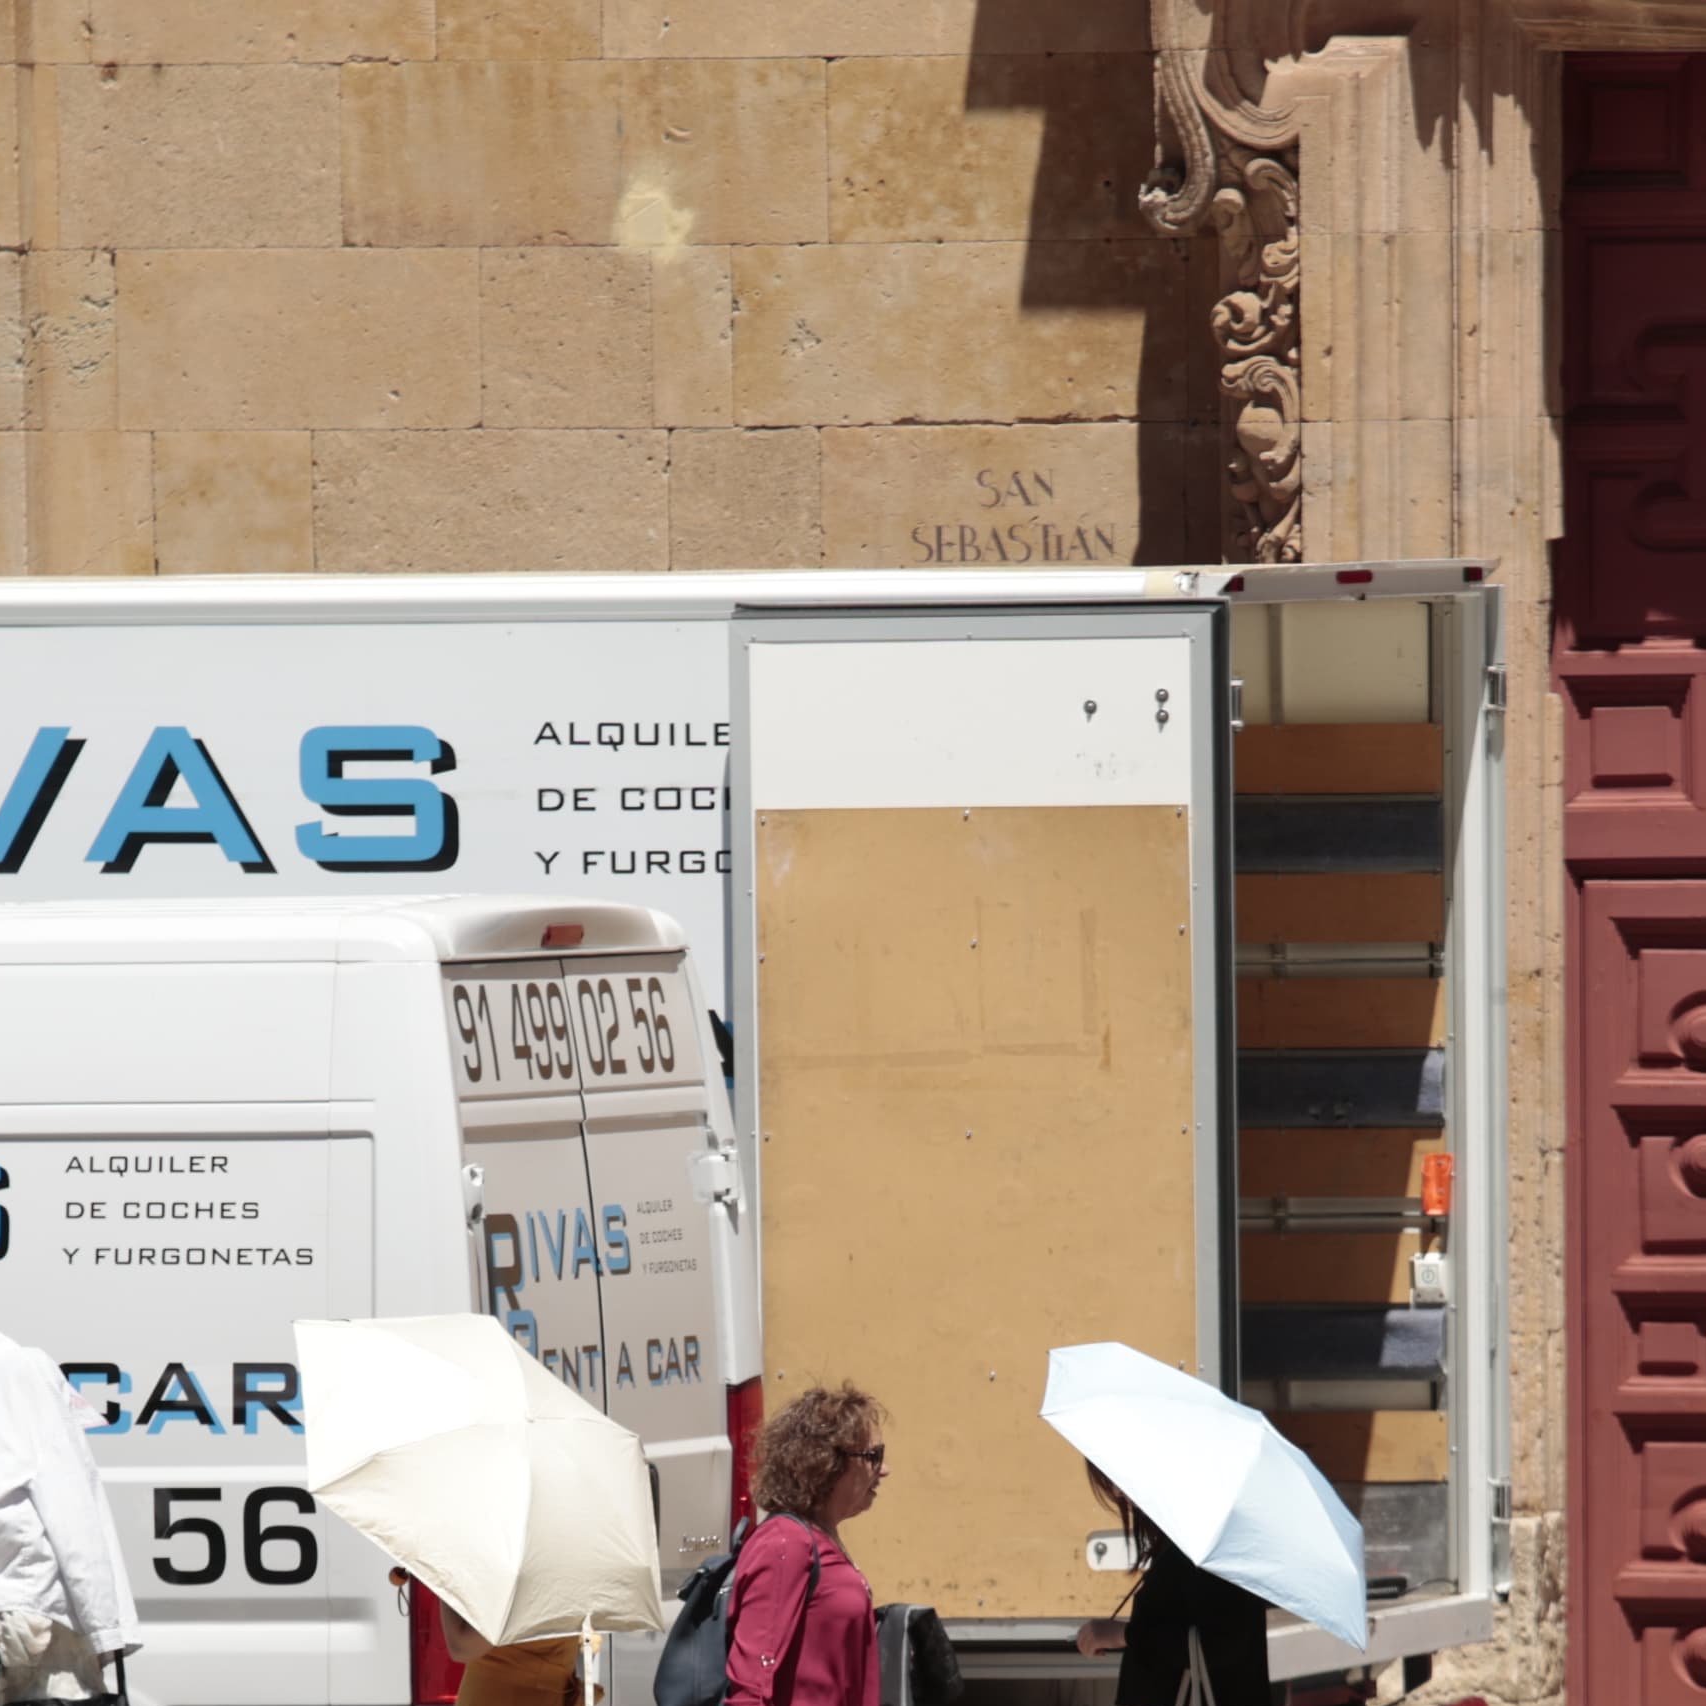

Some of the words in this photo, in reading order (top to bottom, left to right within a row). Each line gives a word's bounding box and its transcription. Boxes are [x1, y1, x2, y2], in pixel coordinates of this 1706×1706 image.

[976, 468, 1059, 508] SAN
[537, 788, 597, 811] DE
[534, 851, 560, 875] Y
[453, 984, 500, 1082] 91
[511, 982, 573, 1080] 499
[577, 978, 627, 1076] 02
[626, 977, 675, 1073] 56
[65, 1156, 229, 1177] ALQUILER
[65, 1202, 107, 1219] DE
[123, 1202, 260, 1219] COCHES
[62, 1248, 80, 1265] Y
[94, 1248, 315, 1265] FURGONETAS
[484, 1204, 631, 1316] RIVAS
[616, 1341, 637, 1390] A
[646, 1335, 702, 1386] CAR
[59, 1362, 305, 1435] CAR
[152, 1486, 318, 1586] 56
